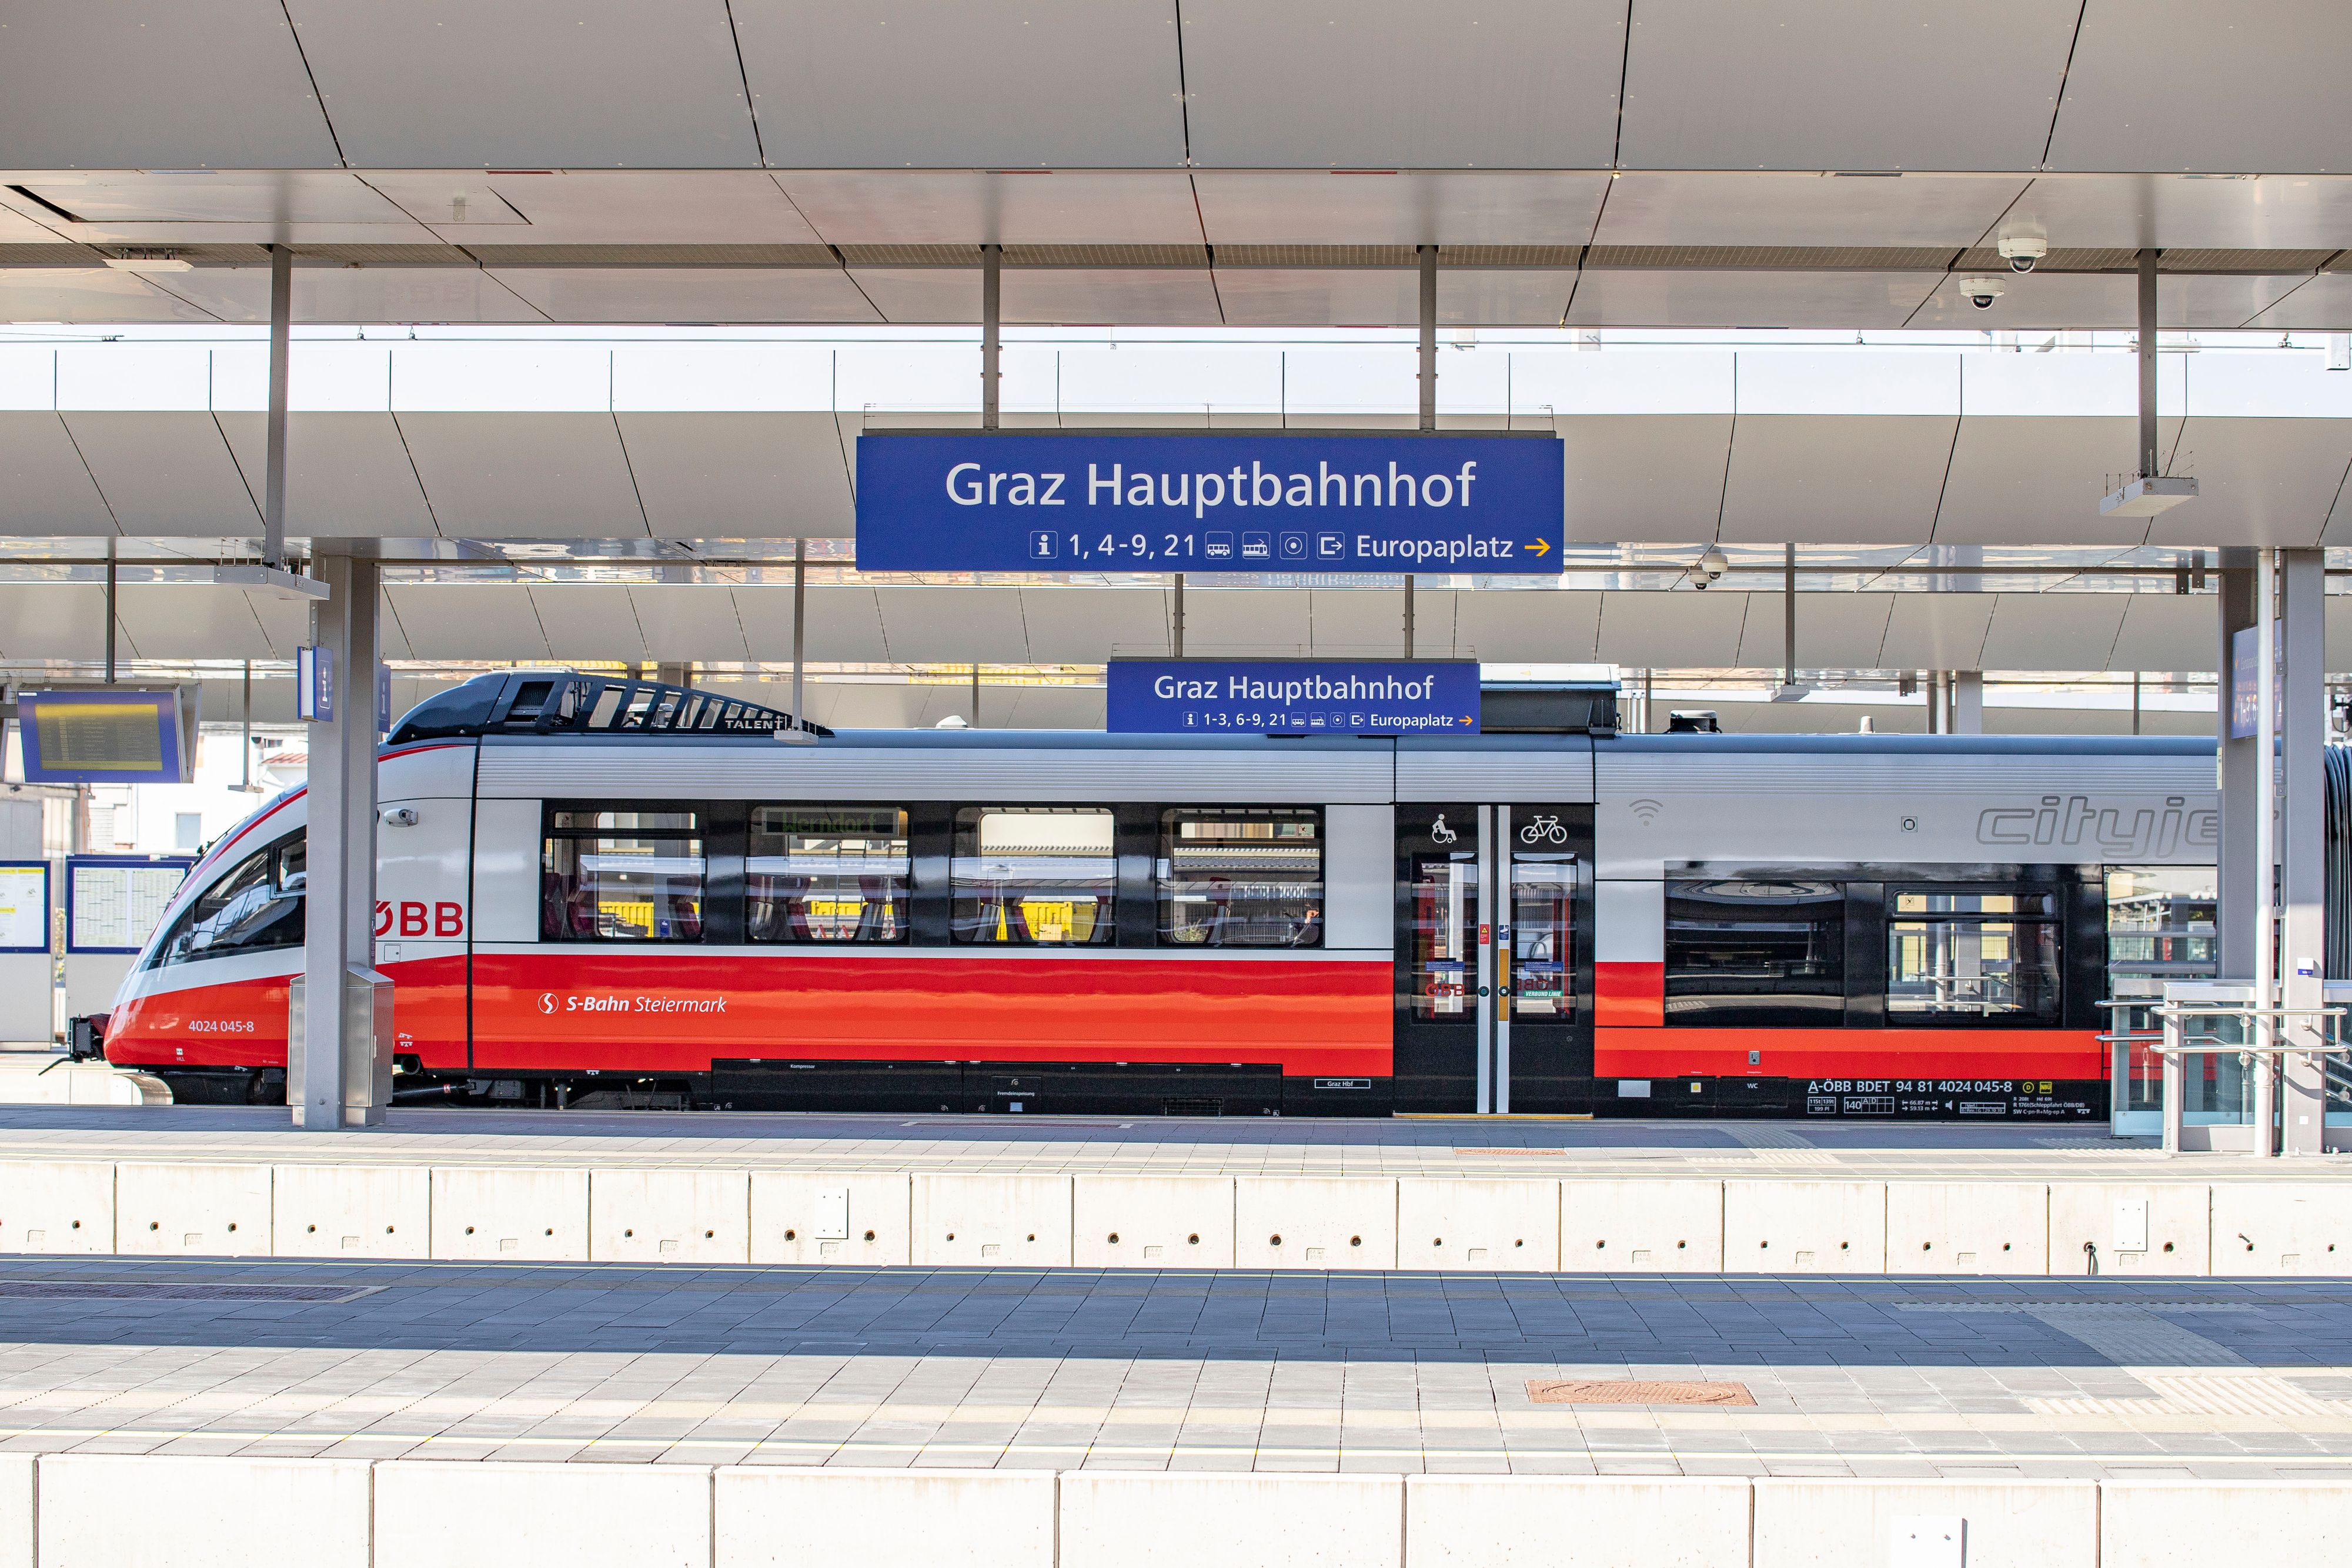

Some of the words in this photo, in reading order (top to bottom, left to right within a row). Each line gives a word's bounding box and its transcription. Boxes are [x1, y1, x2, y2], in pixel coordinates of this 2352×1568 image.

[947, 463, 1065, 505] Graz
[1089, 461, 1476, 518] Hauptbahnhof
[1070, 534, 1088, 559] 1,
[1098, 534, 1154, 559] 4-9,
[1165, 534, 1192, 556] 21
[1358, 534, 1512, 563] Europaplatz
[1155, 676, 1217, 698] Graz
[1230, 675, 1434, 706] Hauptbahnhof
[725, 720, 783, 729] TALENT
[1205, 714, 1231, 727] 1-3,
[1237, 714, 1264, 727] 6-9,
[1269, 714, 1284, 725] 21
[1371, 714, 1453, 729] Europaplatz
[1976, 796, 2217, 859] cityje
[566, 996, 629, 1011] S-Bahn
[634, 996, 727, 1012] Steiermark
[189, 1021, 218, 1032] 4024
[220, 1021, 255, 1032] 045-8
[1808, 1078, 1852, 1093] A-ÖBB
[1857, 1081, 1890, 1092] BDET
[1896, 1081, 1913, 1092] 94
[1917, 1081, 1933, 1092] 81
[1938, 1081, 1972, 1092] 4024
[1975, 1081, 2012, 1092] 045-8
[1846, 1101, 1861, 1109] 140
